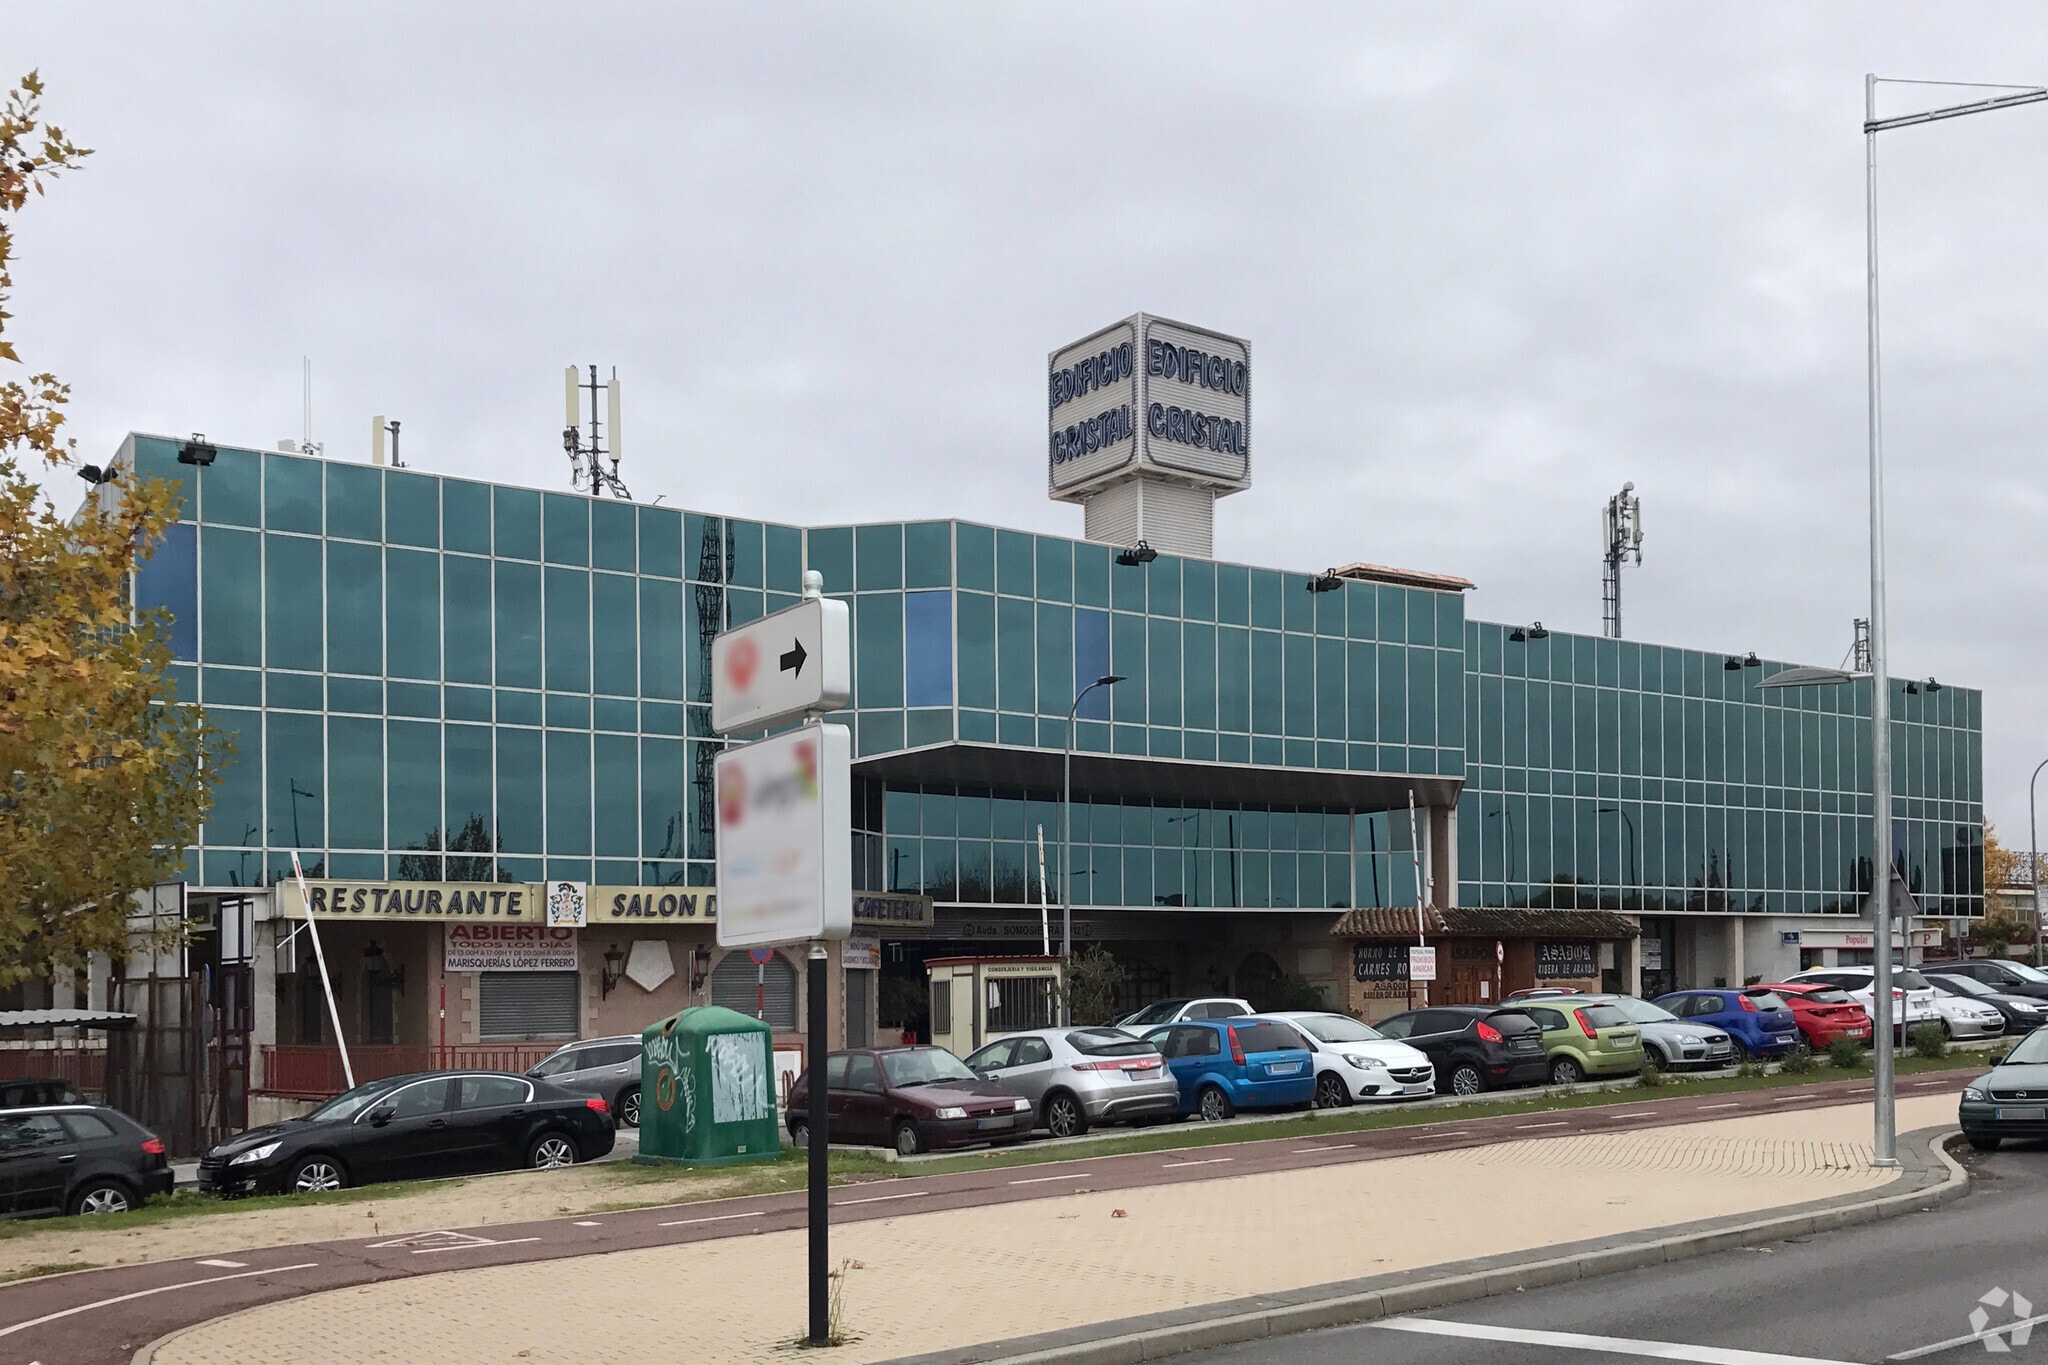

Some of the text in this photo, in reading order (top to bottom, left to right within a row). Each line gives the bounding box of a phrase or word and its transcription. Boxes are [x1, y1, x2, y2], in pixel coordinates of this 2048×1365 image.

[1148, 339, 1247, 396] EDIFICIO
[1050, 342, 1133, 408] EDIFICIO
[1051, 404, 1132, 464] CRISTAL
[1149, 403, 1247, 455] CRISTAL
[310, 887, 523, 915] RESTAURANTE
[611, 893, 716, 916] SALON D
[449, 925, 573, 940] ABIERTO
[1003, 925, 1059, 936] SOMOSIERA
[540, 940, 572, 948] DÍAS
[1845, 935, 1868, 945] Popular
[1923, 934, 1931, 945] P
[1358, 946, 1382, 959] HORNO
[1388, 946, 1398, 958] DE
[1541, 945, 1591, 961] ASADOR
[448, 957, 575, 968] MARISQUERÍAS LÓPEZ FERRERO
[1358, 963, 1391, 976] CARNES
[1374, 982, 1407, 991] ASADOR
